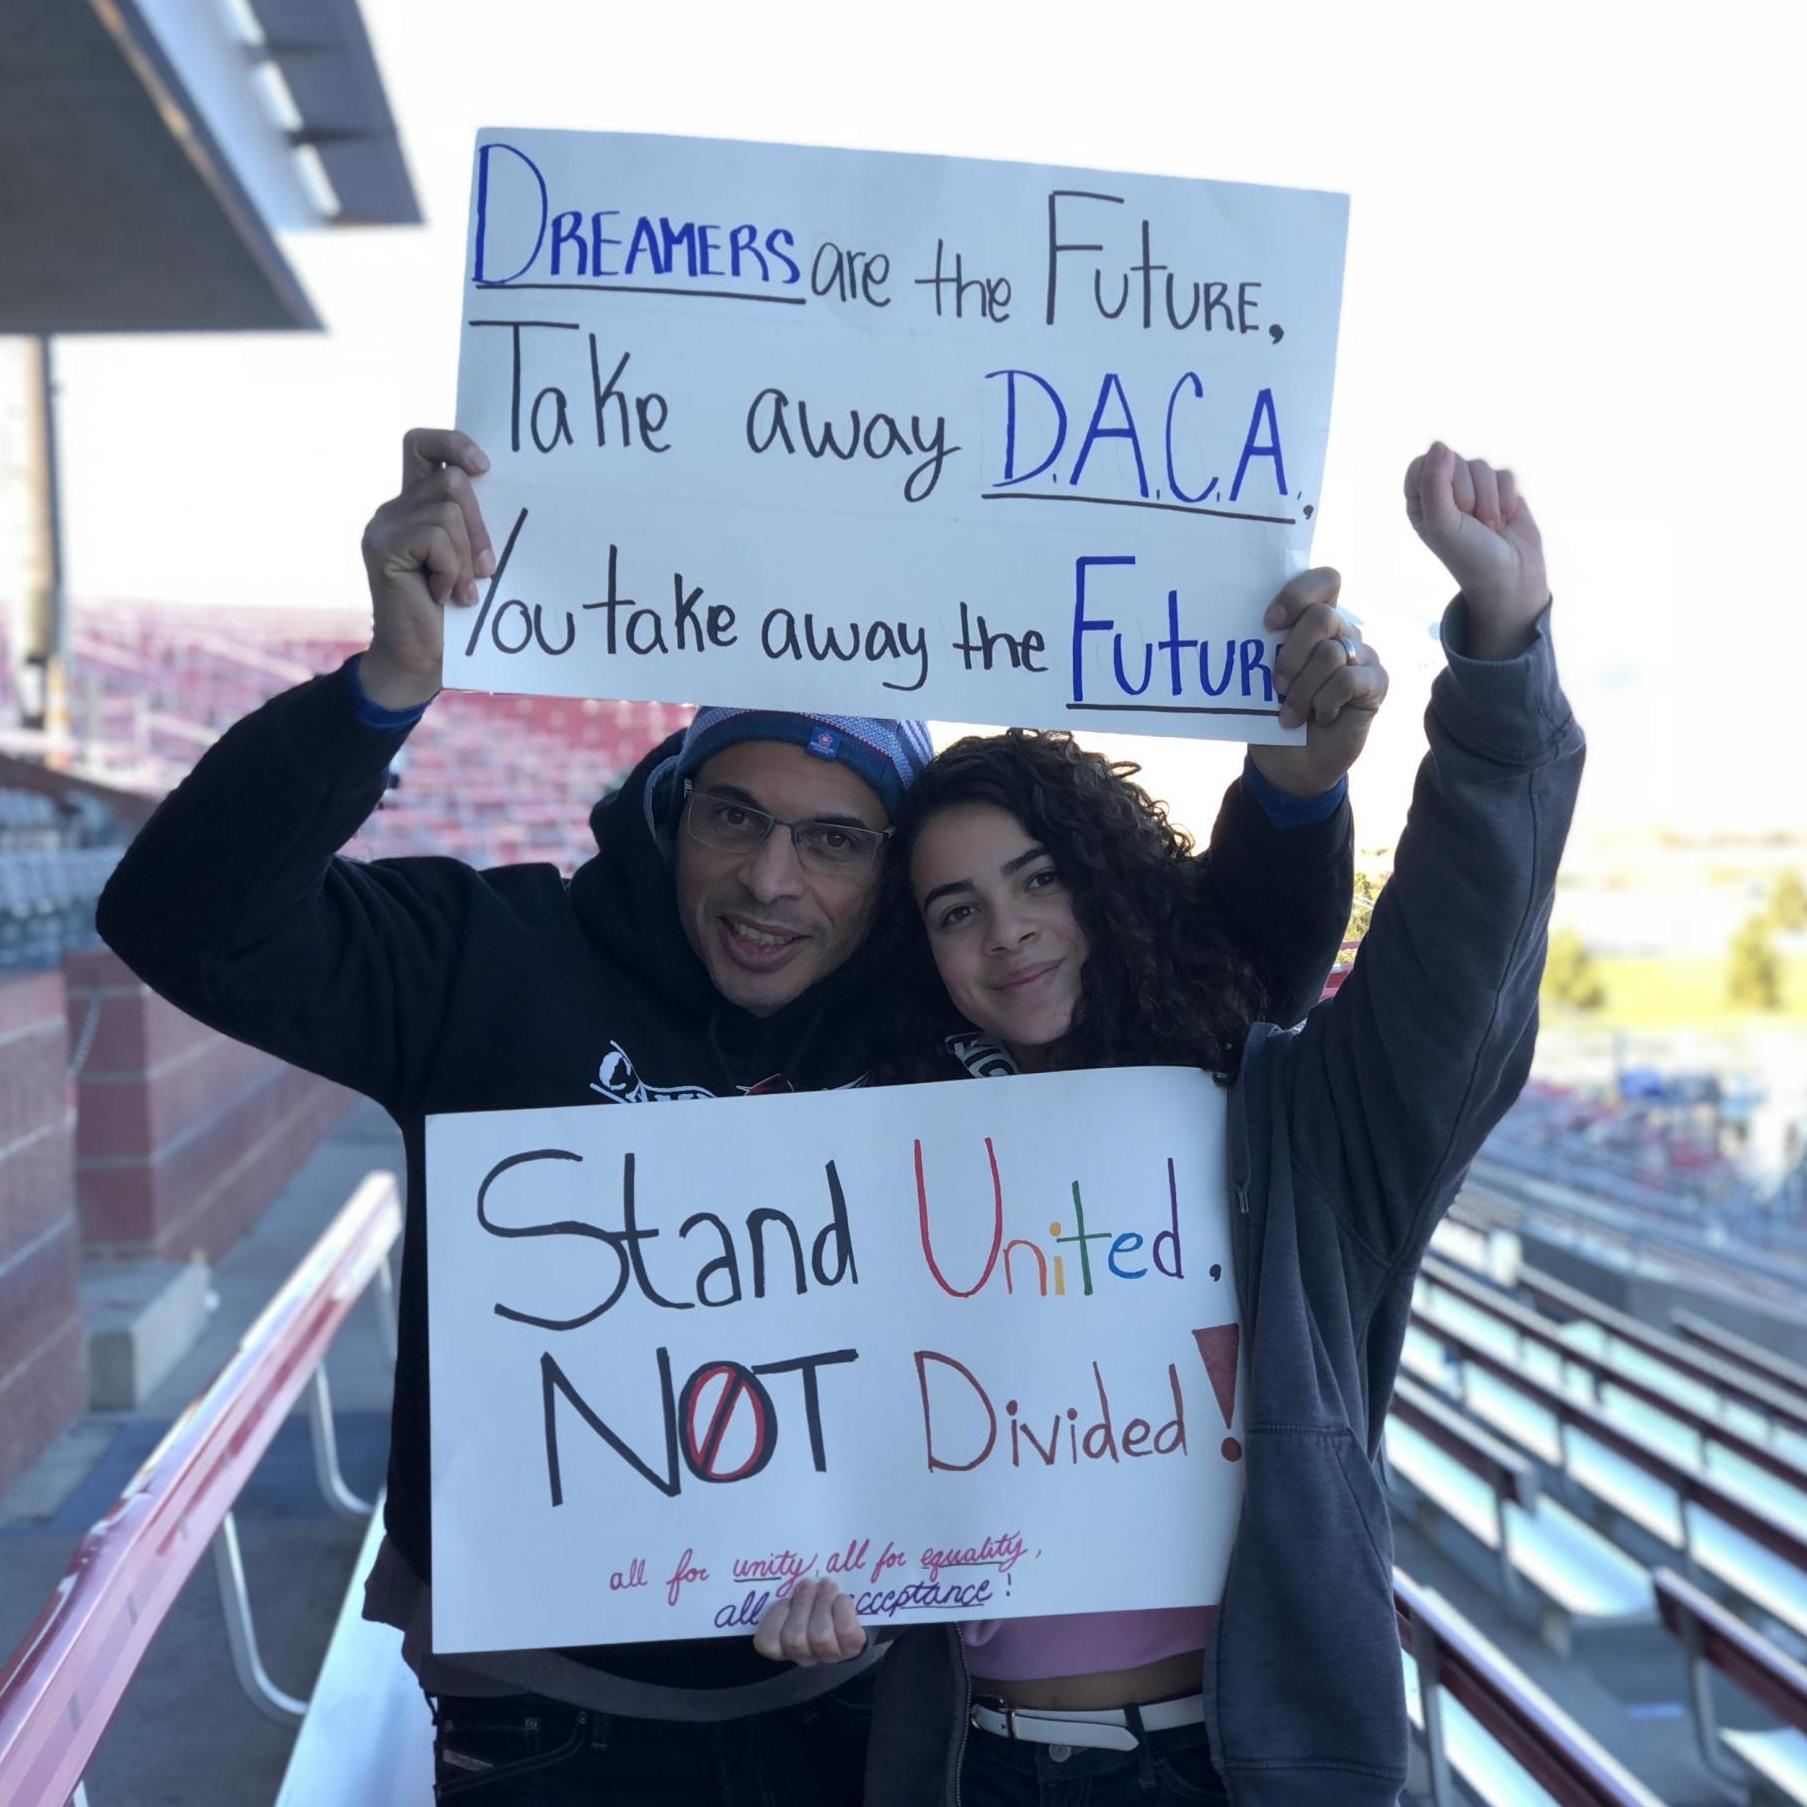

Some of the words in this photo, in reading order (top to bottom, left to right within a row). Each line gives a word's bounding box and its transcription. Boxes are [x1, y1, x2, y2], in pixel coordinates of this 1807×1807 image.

[471, 144, 801, 285] DREAMERS
[811, 242, 891, 306] are
[915, 239, 1011, 322] the
[469, 321, 671, 453] Take
[746, 388, 962, 502] away
[583, 544, 738, 655] take
[762, 608, 929, 691] away
[952, 602, 1049, 672] the
[477, 1149, 859, 1331] Stand
[540, 1347, 859, 1507] NOT
[610, 1559, 648, 1591] all
[666, 1548, 710, 1606] for
[826, 1540, 866, 1573] all
[871, 1542, 906, 1584] for
[714, 1590, 770, 1628] all
[849, 1572, 1011, 1617] cceptance!
